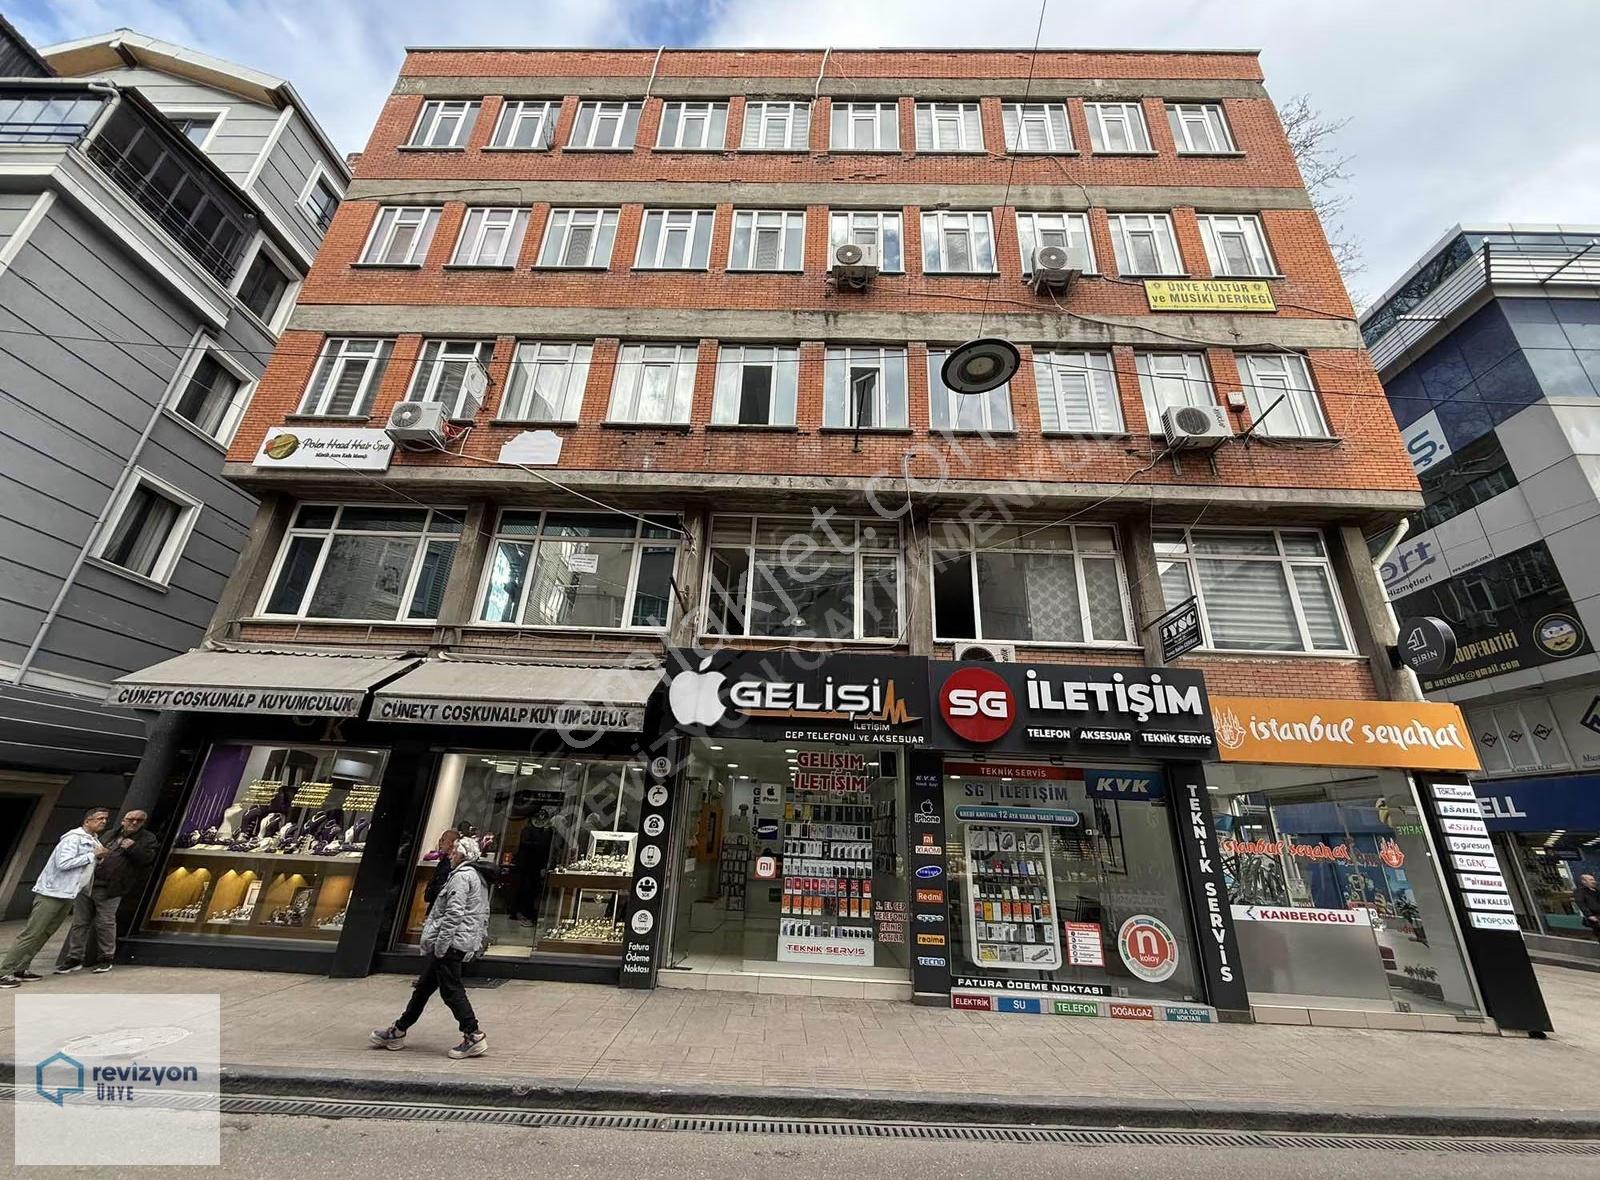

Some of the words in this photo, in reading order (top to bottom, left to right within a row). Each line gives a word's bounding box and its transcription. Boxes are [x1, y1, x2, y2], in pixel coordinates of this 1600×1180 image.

[1167, 281, 1200, 292] ÜNYE
[1203, 282, 1249, 293] KÜLTÜR
[1152, 295, 1166, 303] ve
[1169, 293, 1214, 304] MUSİKİ
[1216, 293, 1272, 305] DERNEĞİ
[302, 438, 325, 450] Polen
[372, 440, 390, 452] Spa
[1411, 650, 1438, 666] ŞİRİN
[118, 687, 173, 704] CÜNEYT
[257, 693, 354, 712] KUYUMCULUK
[1026, 669, 1204, 722] İLETİŞİM
[948, 689, 1008, 719] SG
[381, 699, 438, 719] CÜNEYT
[529, 706, 629, 727] KUYUMCULUK
[853, 722, 890, 732] İLETİŞİM
[785, 731, 804, 739] CEP
[806, 731, 856, 741] TELEFONU
[872, 734, 924, 744] AKSESUAR
[1027, 728, 1071, 739] TELEFON
[1080, 730, 1132, 742] AKSESUAR
[1142, 732, 1177, 744] TEKNİK
[1178, 734, 1212, 745] SERVİS
[1362, 719, 1465, 751] seyahat
[797, 750, 864, 773] GELİŞİM
[981, 767, 1014, 777] TEKNİK
[1015, 768, 1047, 778] SERVİS
[793, 772, 867, 796] İLETİŞİM
[1096, 777, 1151, 793] KVK
[964, 782, 985, 798] SG
[1000, 783, 1068, 803] İLETİŞİM
[914, 813, 941, 823] iPhone
[999, 810, 1008, 819] 12
[1186, 784, 1214, 875] TEKNİK
[916, 846, 941, 854] XIAOMI
[918, 892, 942, 901] Redmi
[1472, 897, 1487, 905] VAN
[1260, 910, 1356, 924] KANBEROĞLU
[1205, 882, 1234, 983] SERVİS
[918, 935, 944, 944] realme
[628, 942, 650, 951] Fatura
[787, 944, 822, 953] TEKNİK
[625, 951, 650, 962] Ödeme
[918, 957, 946, 967] TECNO
[1140, 954, 1160, 964] kolay
[623, 964, 650, 973] Noktası
[957, 978, 1002, 988] FATURA
[1008, 980, 1049, 991] ÖDEME
[1052, 984, 1104, 995] NOKTASI
[955, 997, 990, 1007] ELEKTRİK
[1013, 999, 1027, 1010] SU
[1056, 1002, 1097, 1014] TELEFON
[1111, 1005, 1153, 1018] DOĞALGAZ
